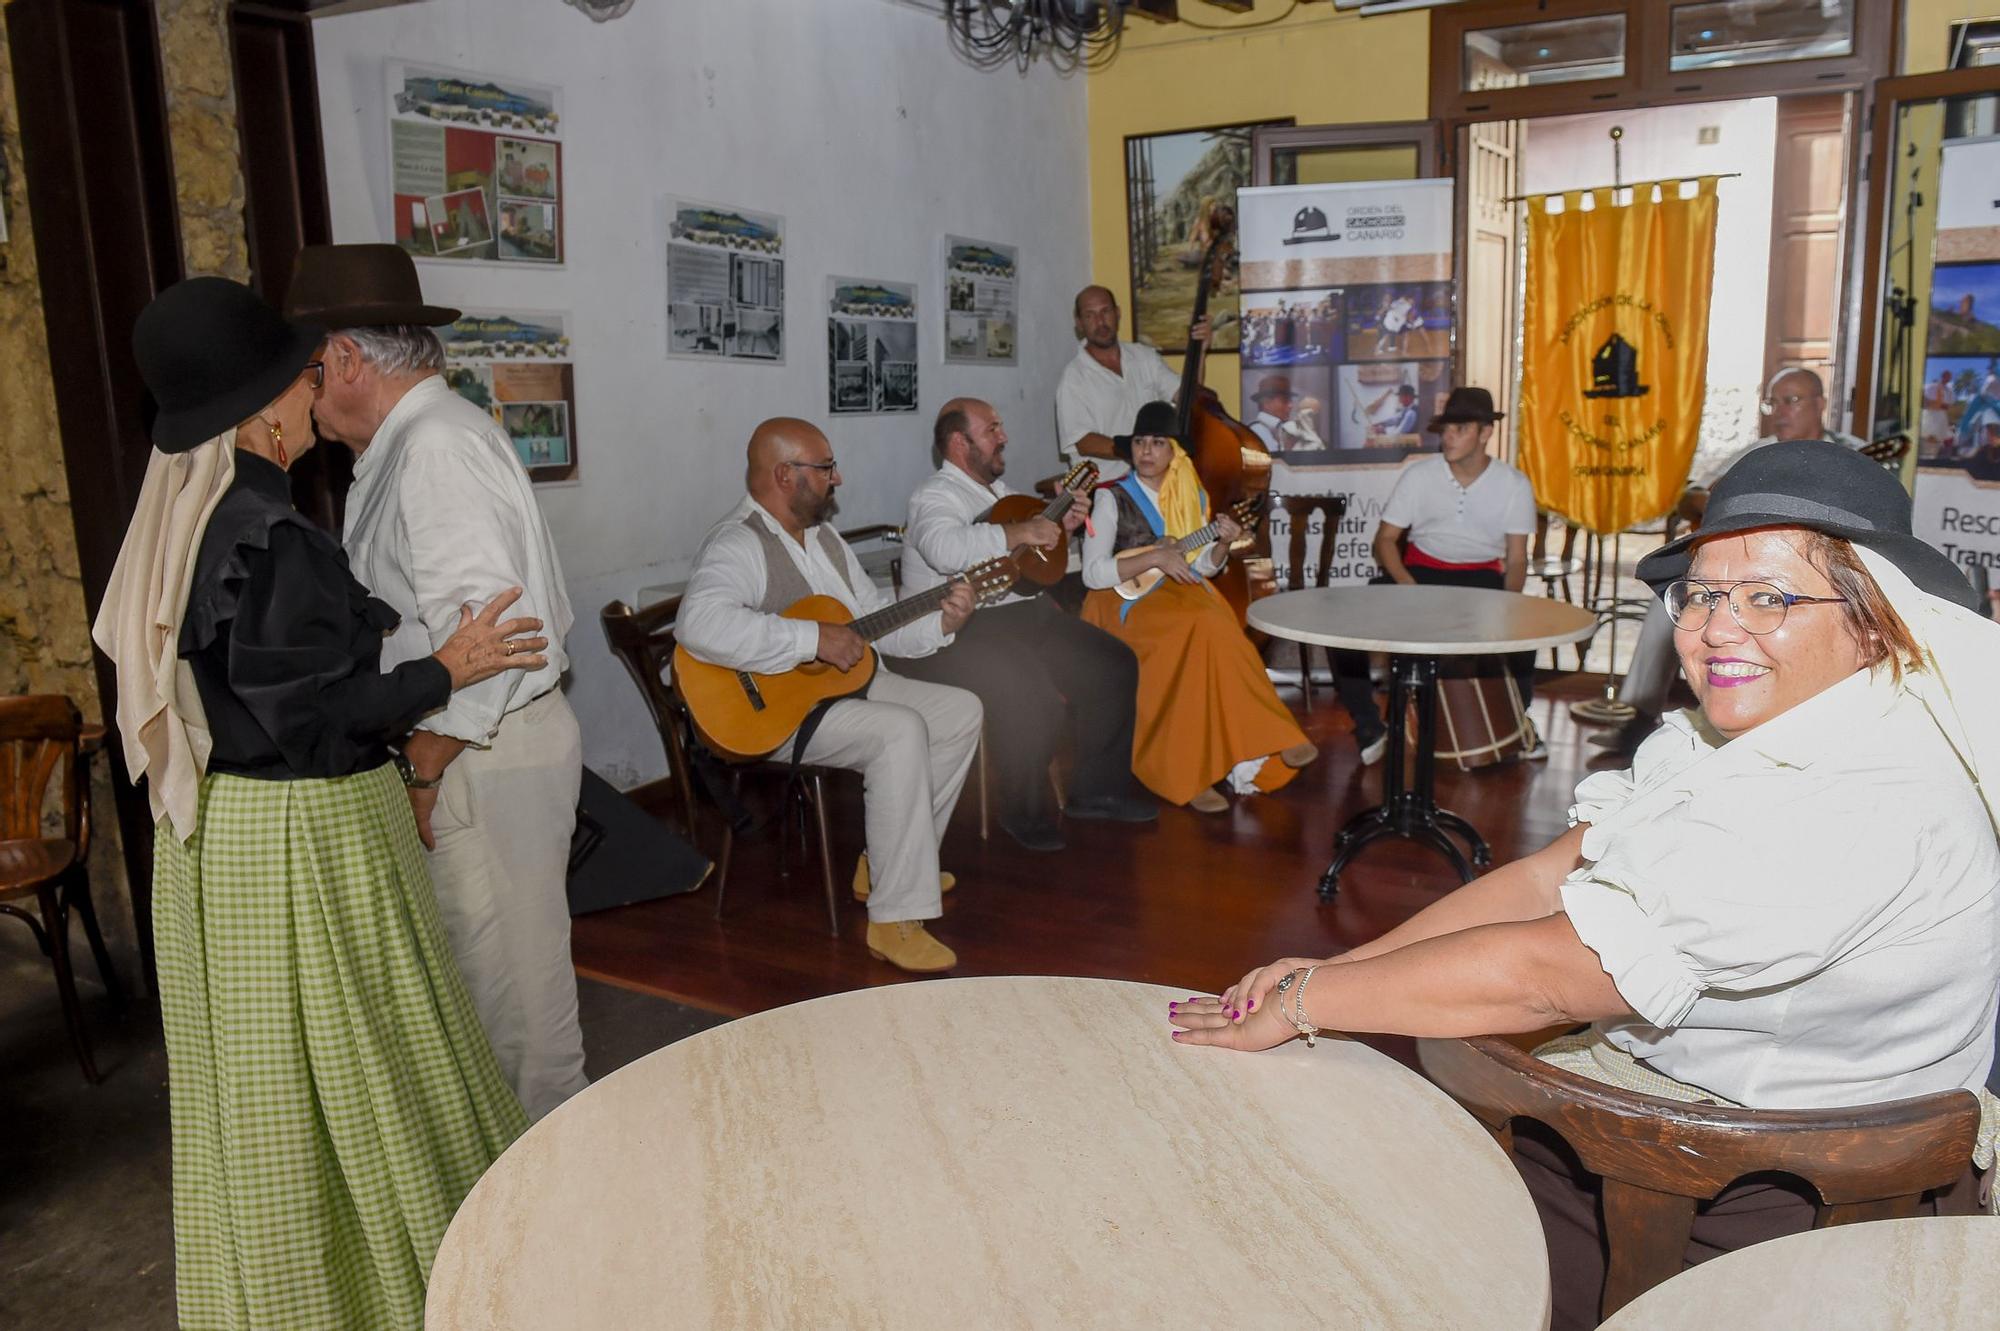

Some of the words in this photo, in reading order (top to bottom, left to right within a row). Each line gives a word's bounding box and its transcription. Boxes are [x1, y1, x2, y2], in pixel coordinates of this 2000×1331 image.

[1346, 205, 1382, 216] ORDEN
[1383, 203, 1404, 214] DEL
[1346, 229, 1405, 241] CANARIO
[1616, 294, 1633, 305] DE
[1271, 517, 1367, 536] Trsitir
